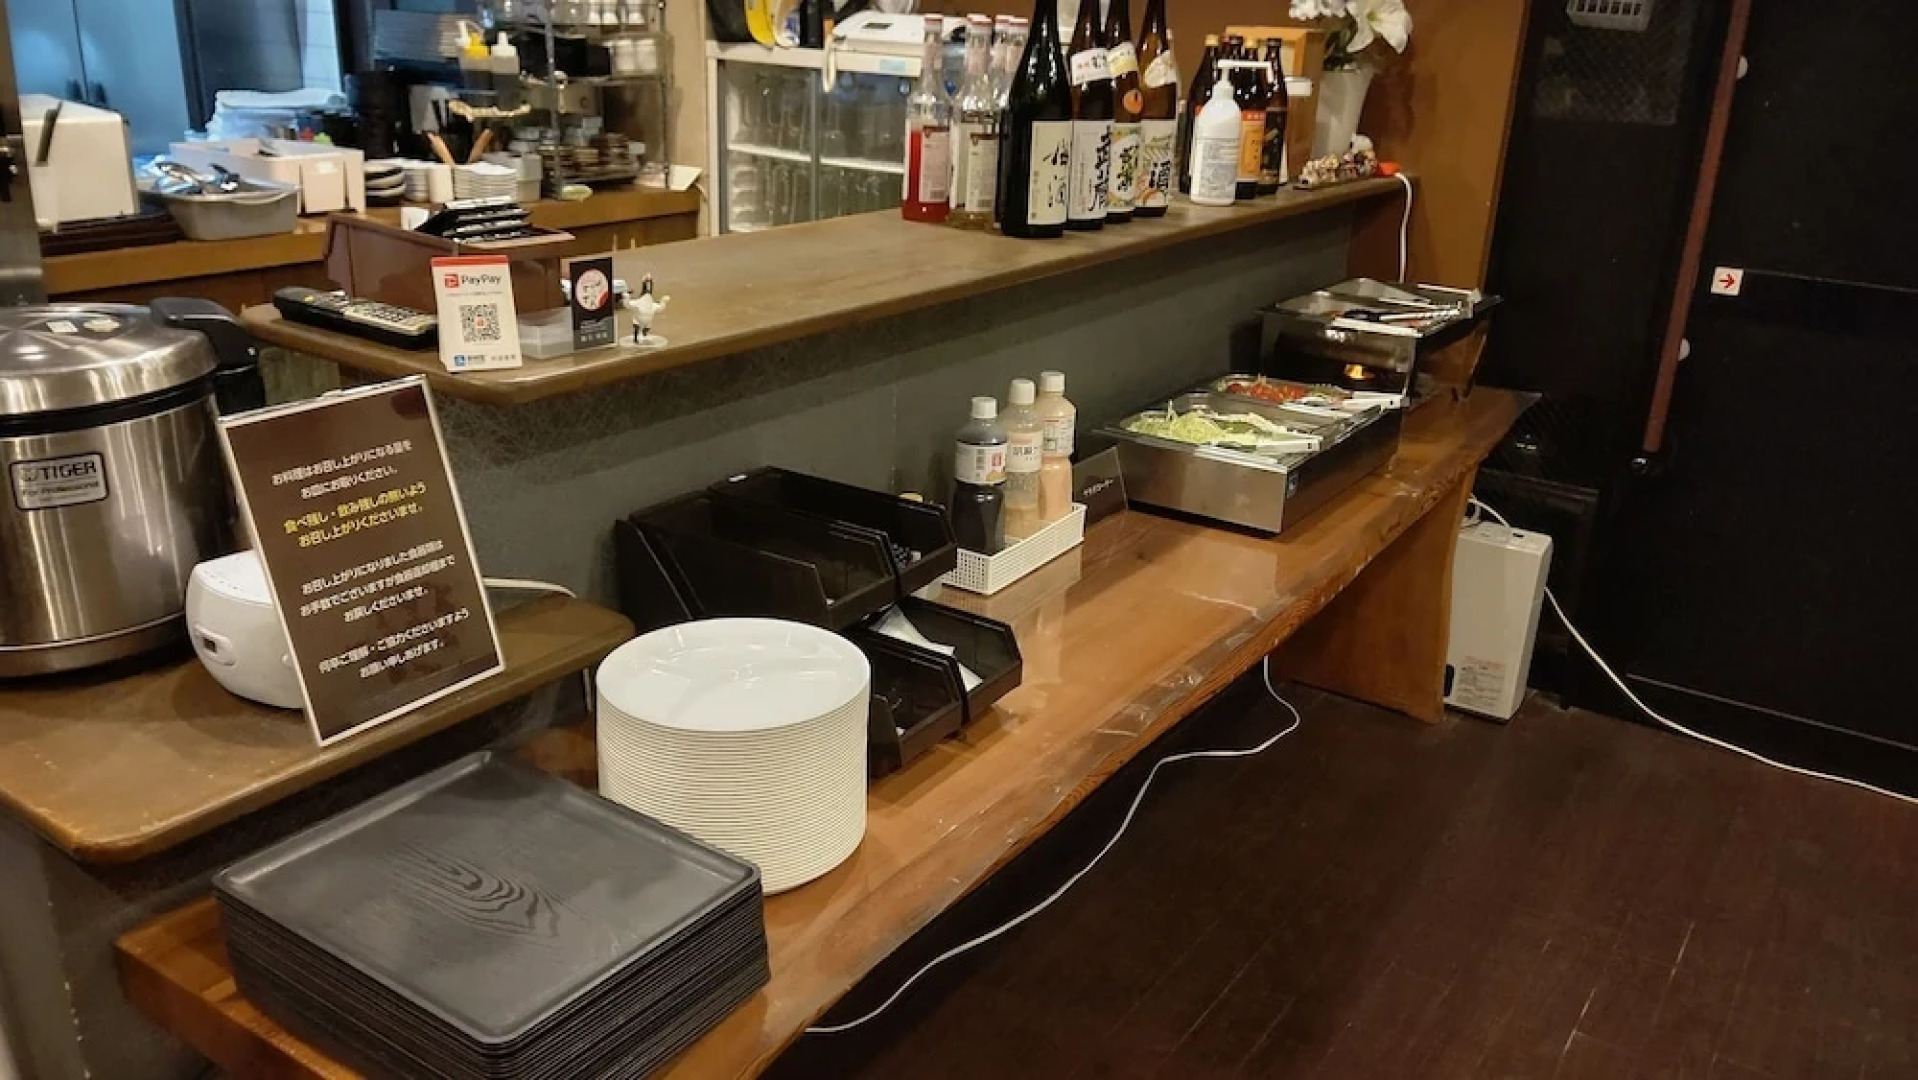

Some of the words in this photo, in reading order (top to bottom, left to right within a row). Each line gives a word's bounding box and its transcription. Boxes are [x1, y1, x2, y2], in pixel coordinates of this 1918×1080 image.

[461, 274, 502, 286] PayPay
[39, 460, 97, 480] TIGER
[298, 502, 423, 548] お召し上がりくださいませ。
